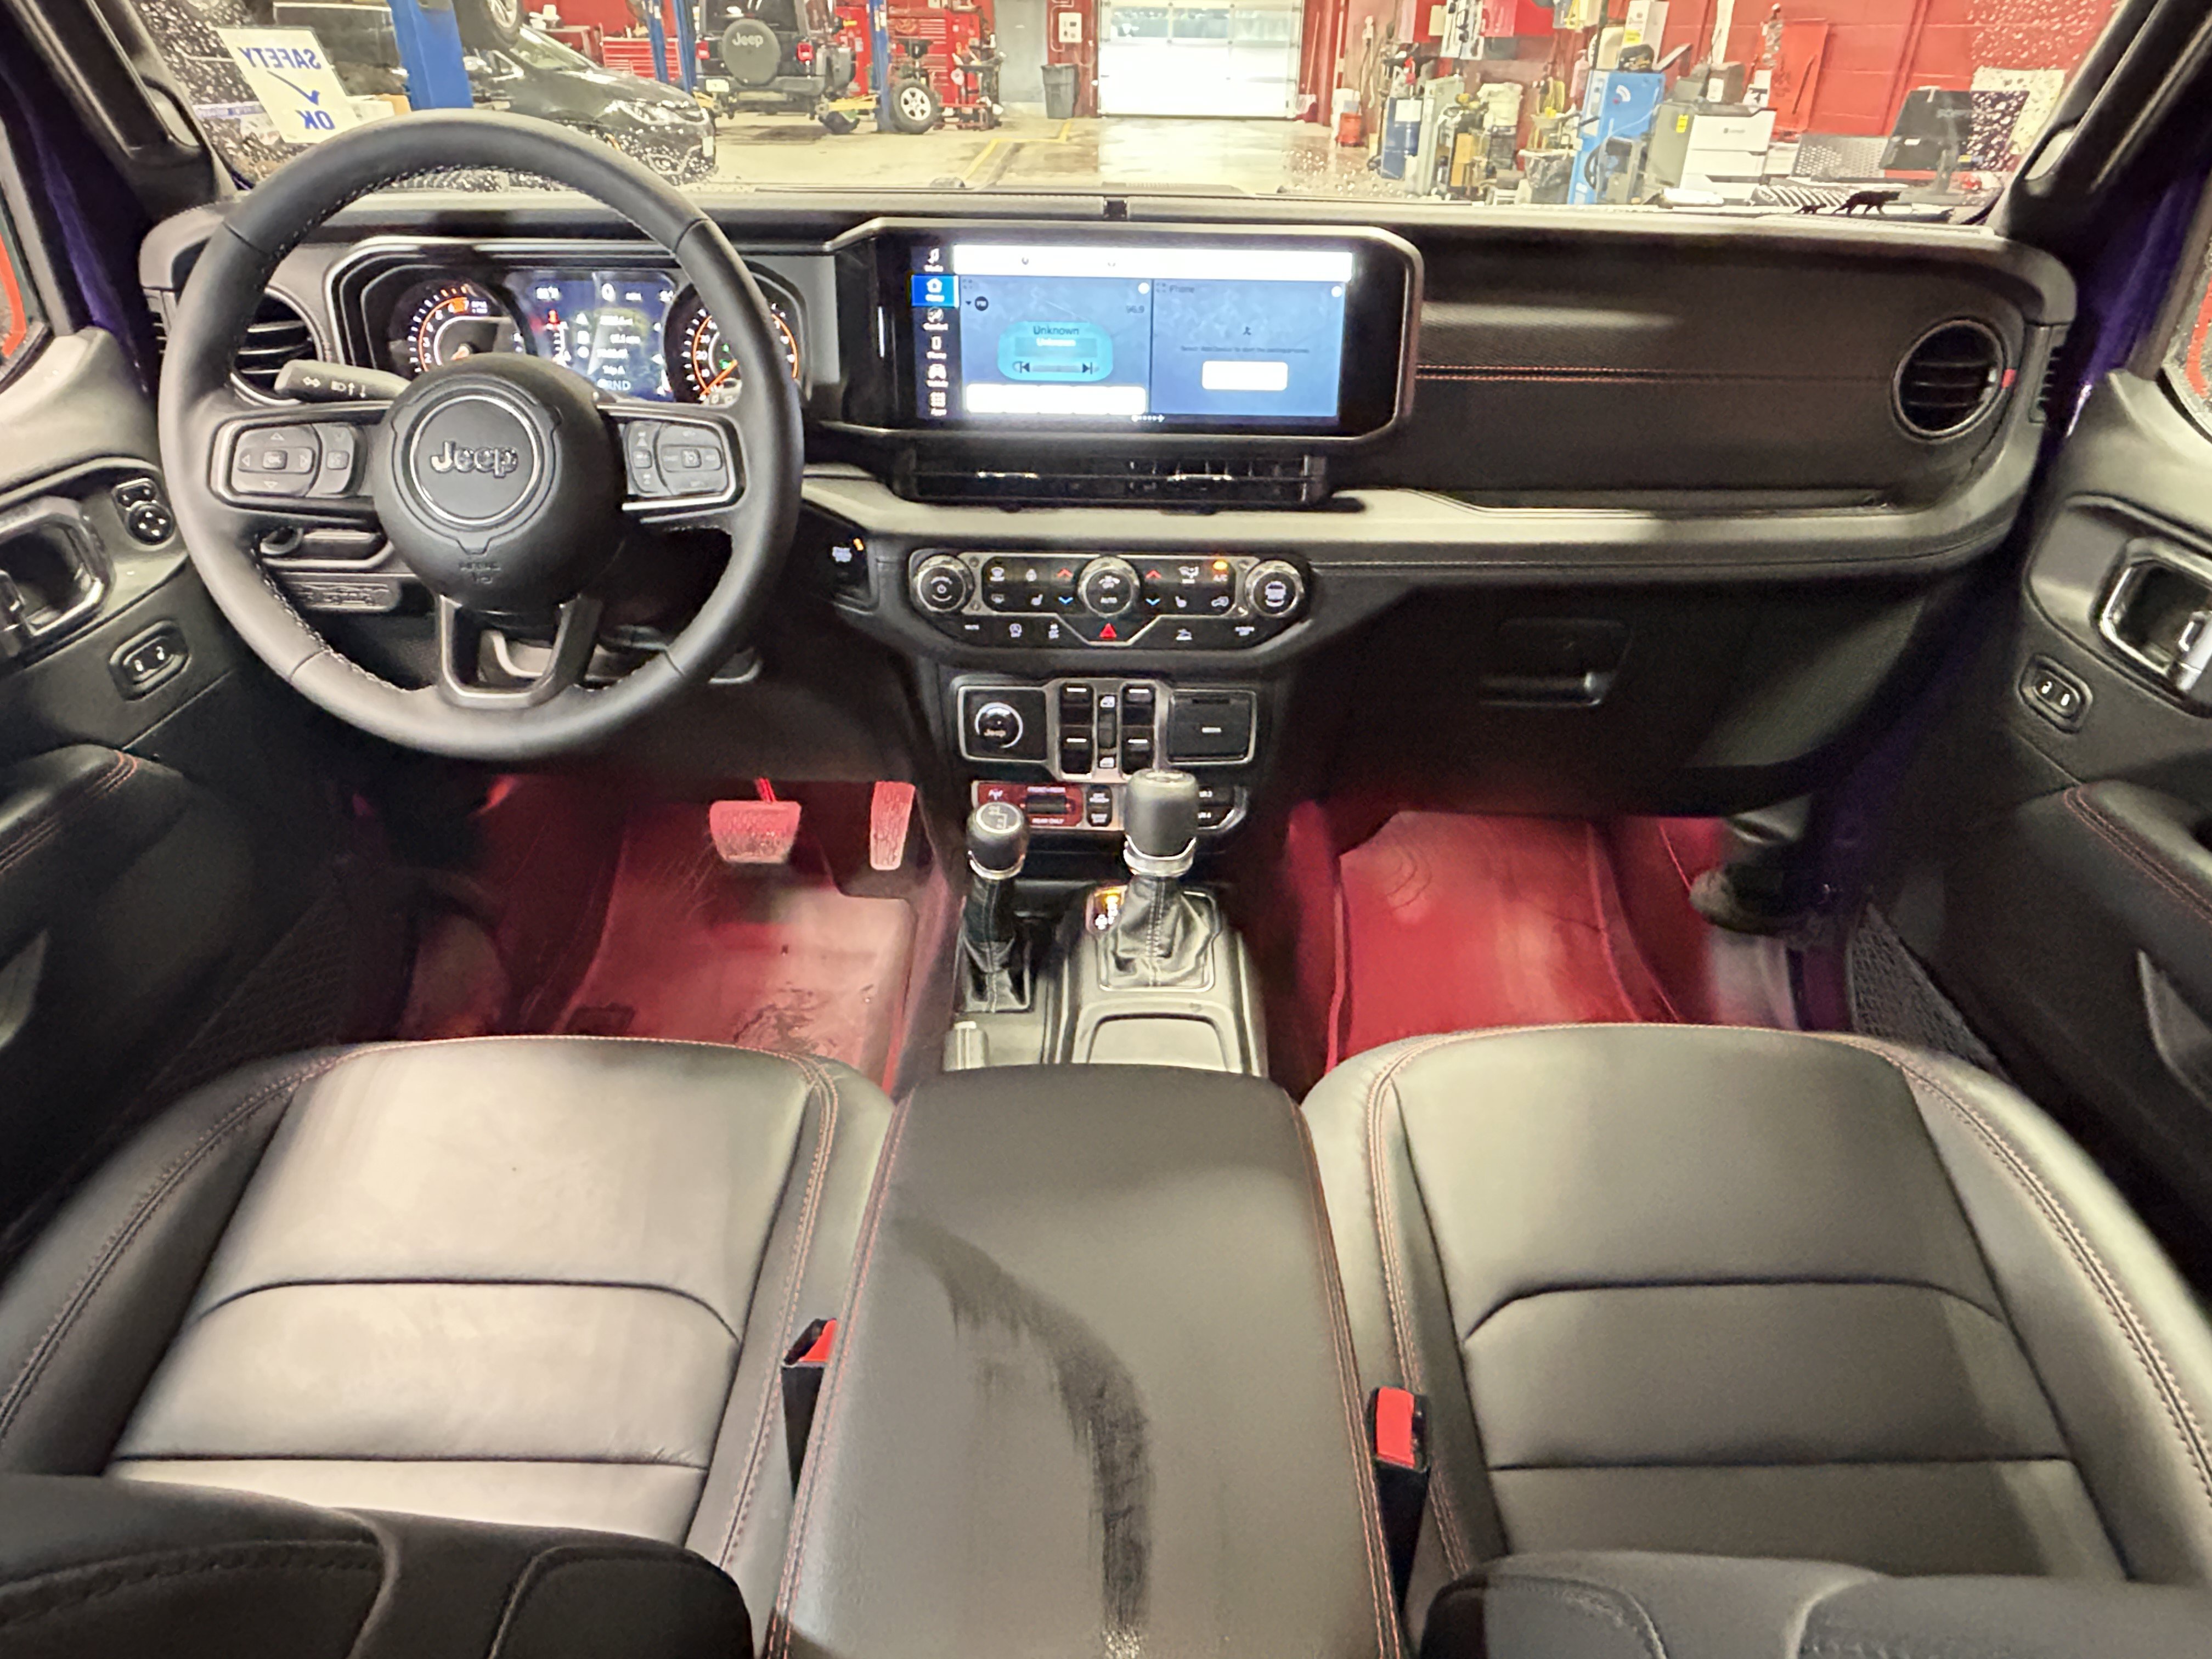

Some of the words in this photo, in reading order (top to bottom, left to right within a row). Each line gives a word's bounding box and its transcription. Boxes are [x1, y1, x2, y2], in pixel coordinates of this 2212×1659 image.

[732, 32, 764, 48] Jeep
[1033, 325, 1079, 336] Unknown
[423, 337, 430, 348] 3
[424, 352, 432, 364] 2
[430, 441, 518, 478] Jeep
